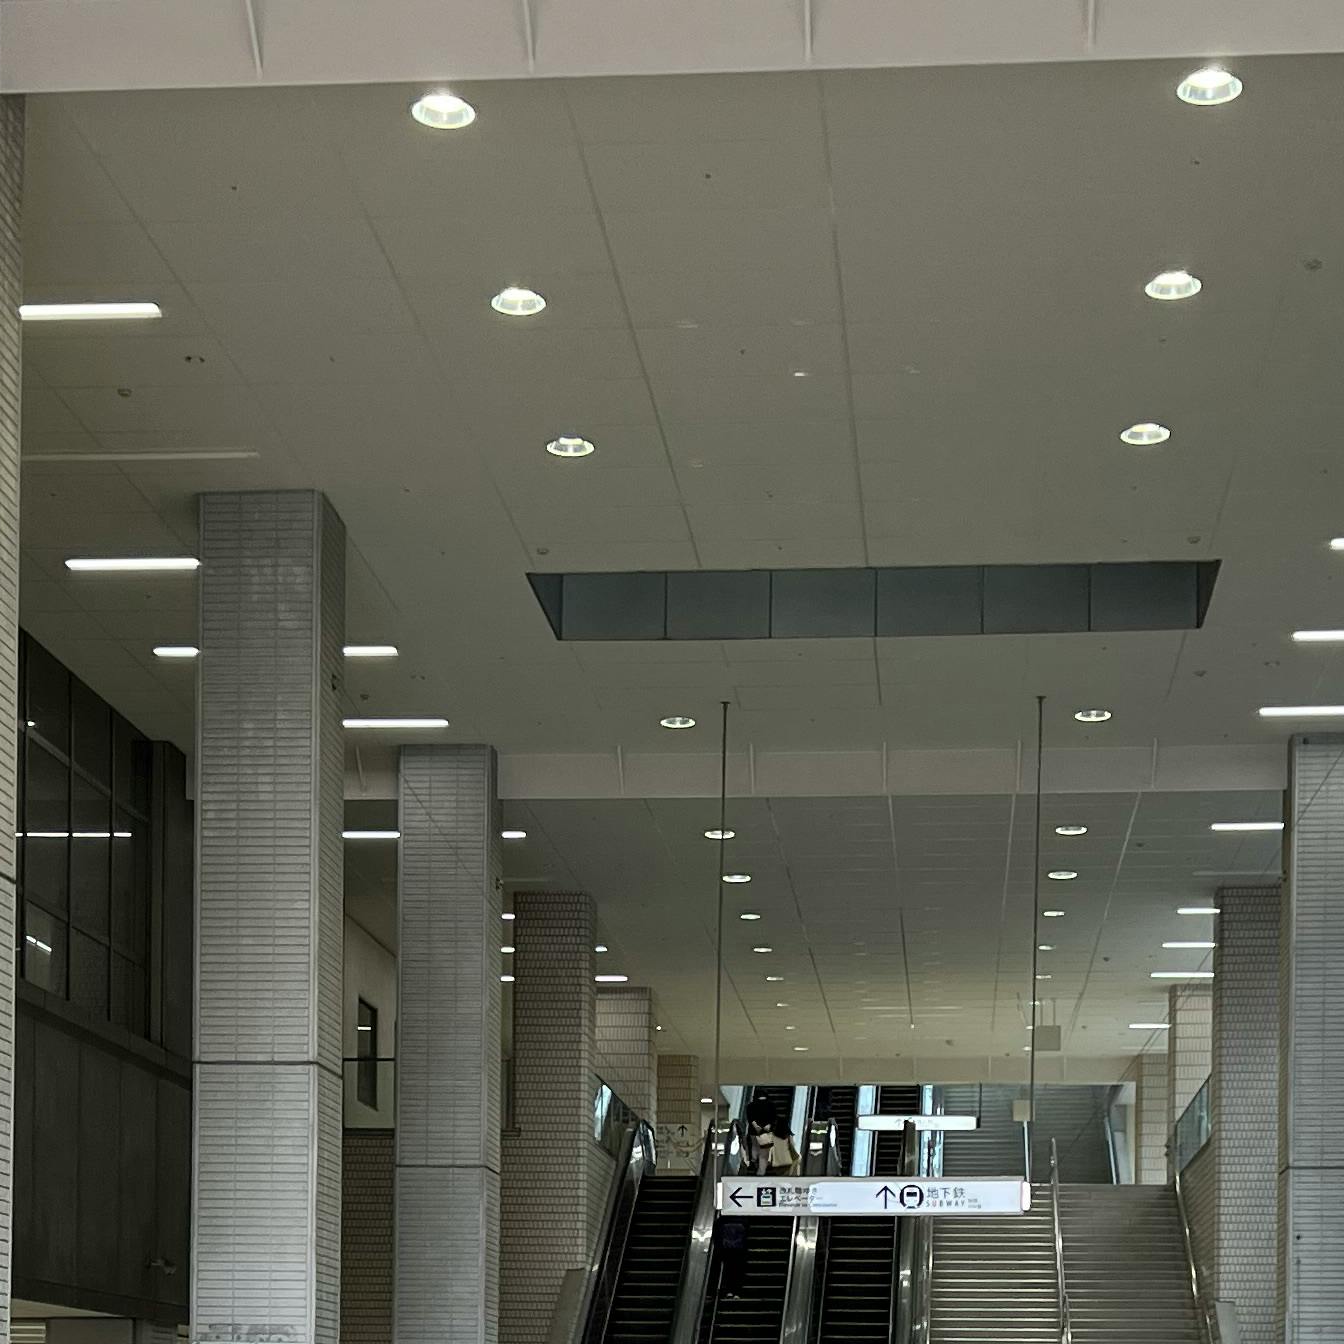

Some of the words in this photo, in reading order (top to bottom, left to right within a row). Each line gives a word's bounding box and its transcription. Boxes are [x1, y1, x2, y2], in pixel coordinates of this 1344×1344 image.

[927, 1187, 965, 1198] 地下鉄
[925, 1200, 965, 1208] SUBWAY
